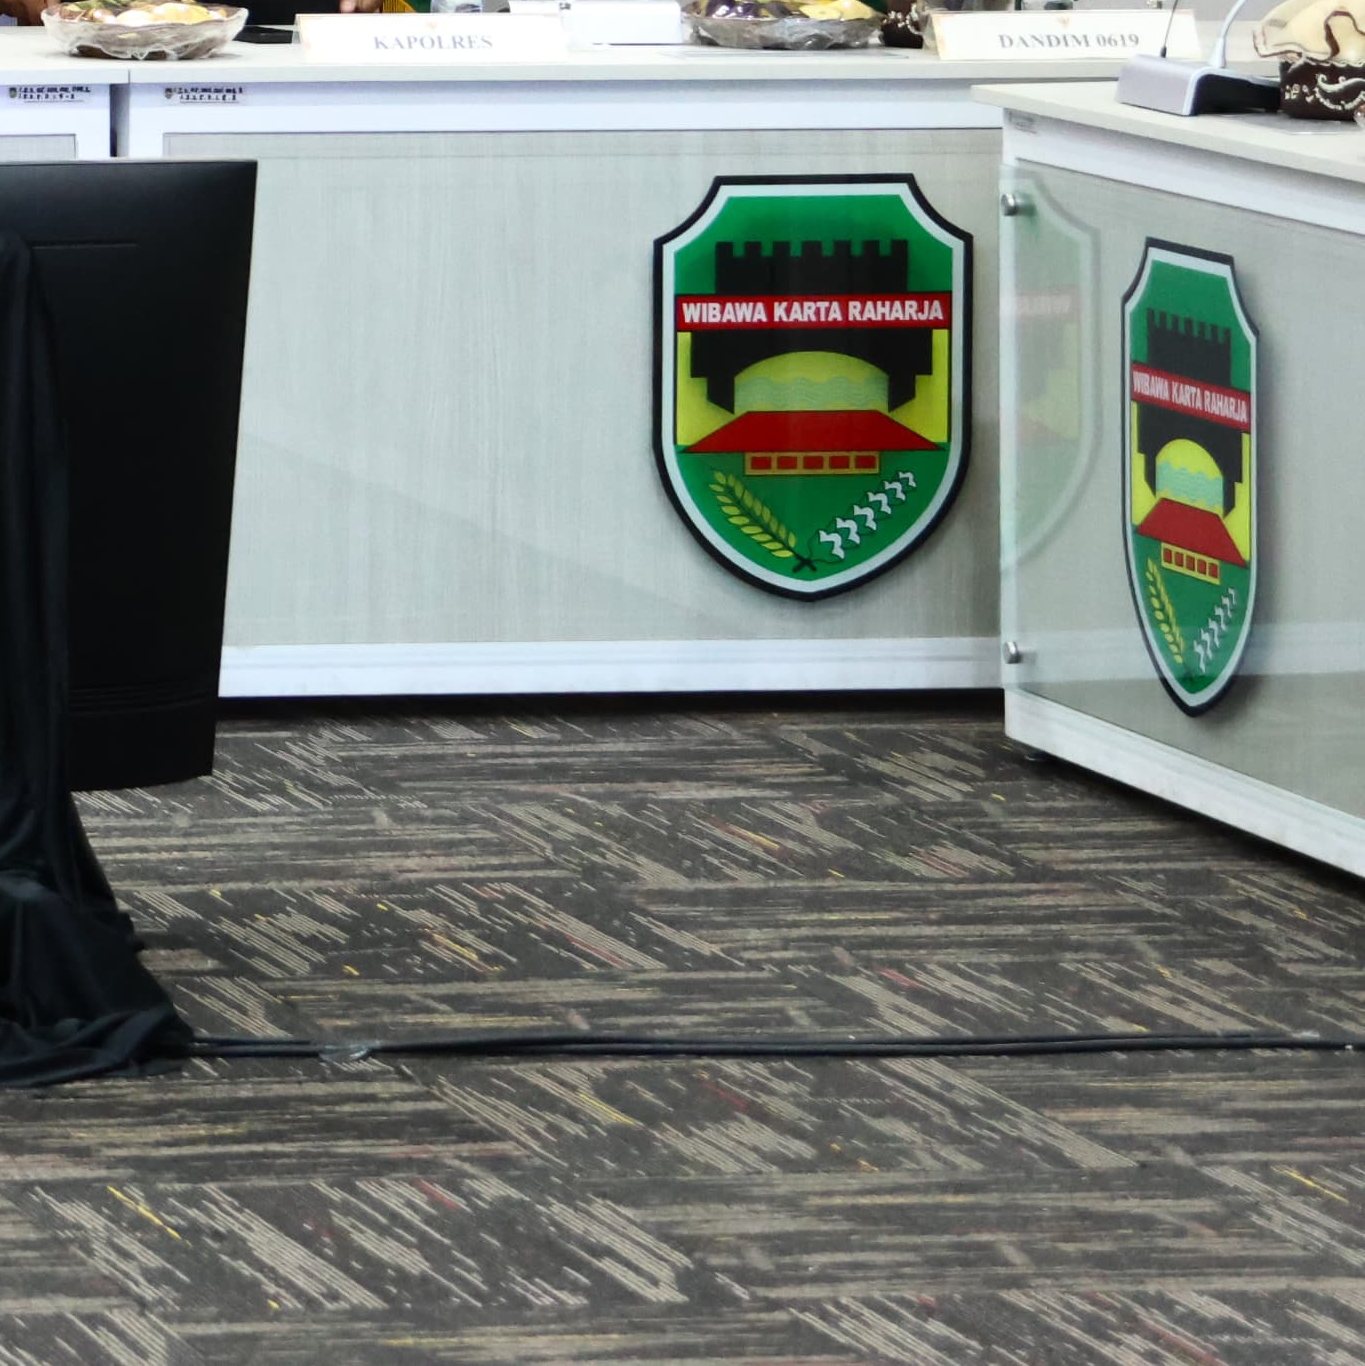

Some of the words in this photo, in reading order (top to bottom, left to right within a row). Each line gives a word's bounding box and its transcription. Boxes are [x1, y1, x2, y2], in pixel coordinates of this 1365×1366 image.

[373, 34, 493, 50] KAPOLRES
[998, 33, 1090, 48] DANDIM
[1095, 34, 1140, 48] 0619
[682, 302, 768, 323] WIBAWA
[773, 301, 843, 322] KARTA
[848, 300, 944, 321] RAHARJA
[1132, 370, 1170, 401] WIBAWA
[1171, 381, 1203, 411] KARTA
[1204, 390, 1248, 423] RAHARJA
